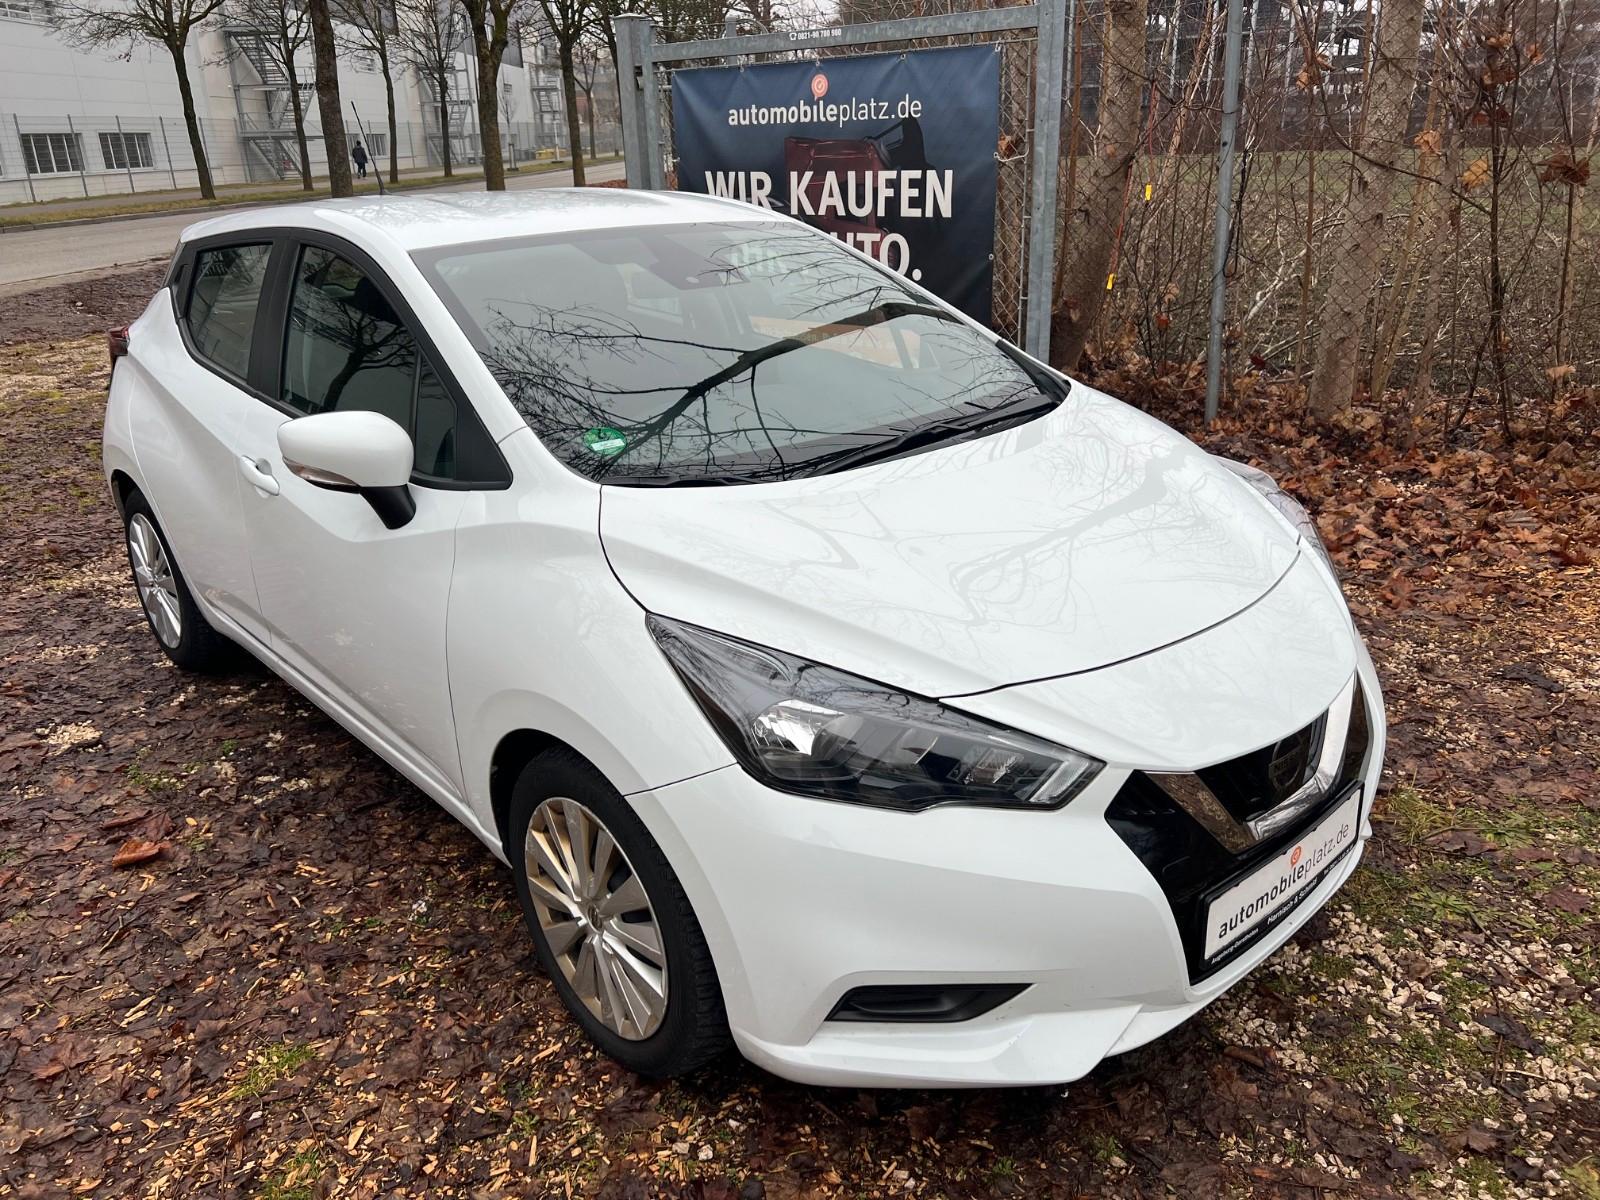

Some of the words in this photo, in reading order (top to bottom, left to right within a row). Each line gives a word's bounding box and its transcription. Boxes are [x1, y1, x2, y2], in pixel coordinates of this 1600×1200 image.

[728, 93, 922, 128] automobileplatz.de
[790, 169, 953, 218] KAUFEN
[1218, 823, 1349, 939] automobileplatz.de
